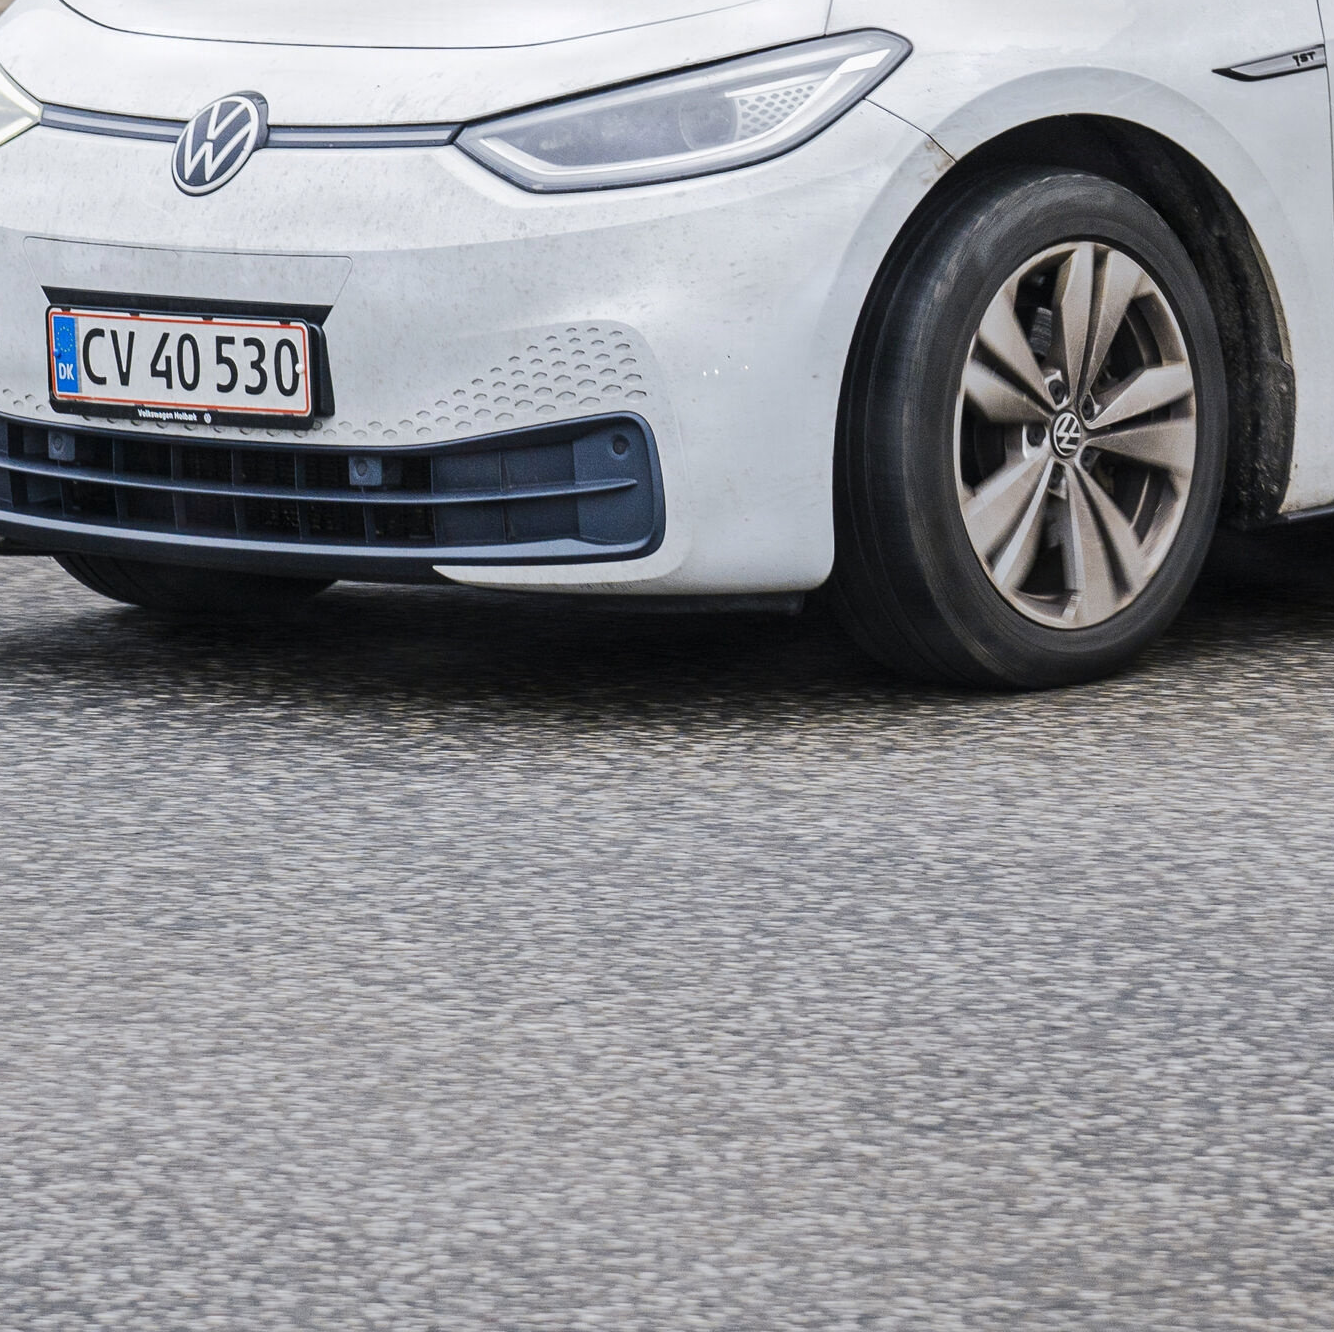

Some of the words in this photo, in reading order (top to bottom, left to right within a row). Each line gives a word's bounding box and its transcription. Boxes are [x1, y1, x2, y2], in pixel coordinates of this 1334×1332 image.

[1292, 51, 1316, 67] 1ST
[82, 328, 135, 386] CV
[150, 332, 200, 392] 40
[216, 335, 302, 397] 530
[58, 362, 75, 381] DK
[137, 408, 174, 421] Volkswagen
